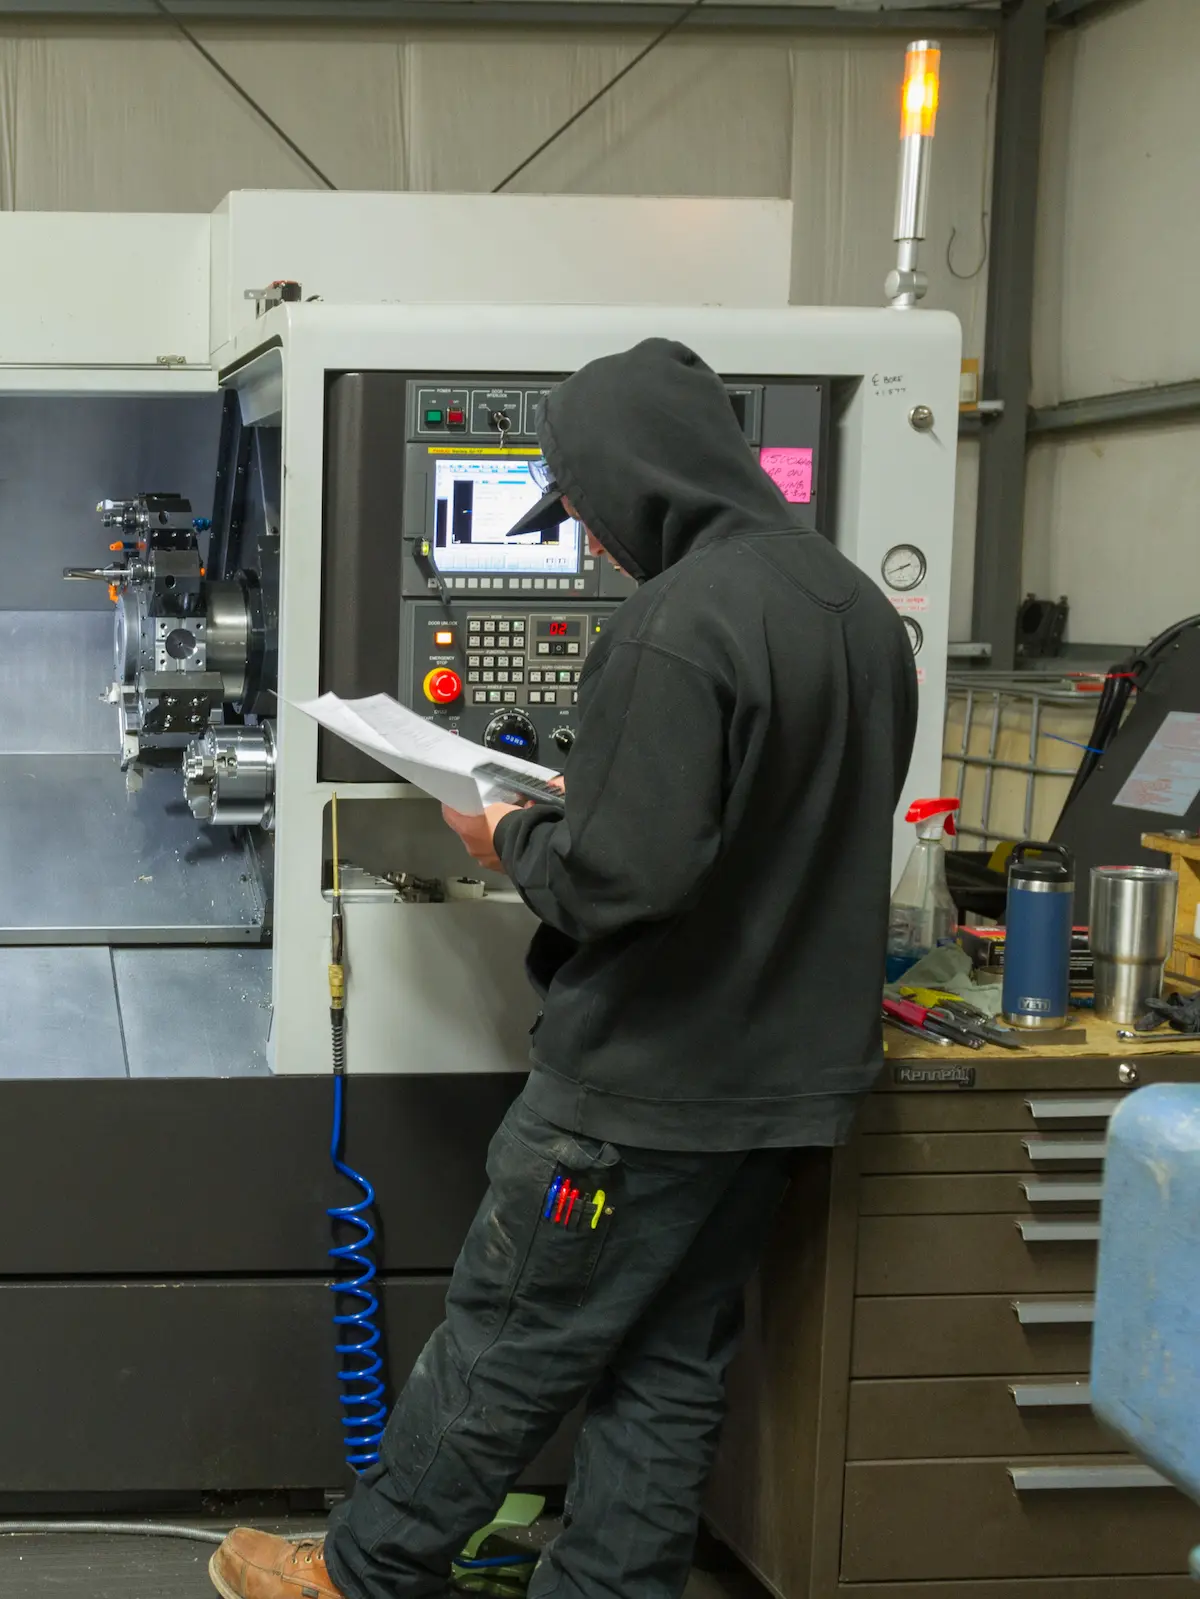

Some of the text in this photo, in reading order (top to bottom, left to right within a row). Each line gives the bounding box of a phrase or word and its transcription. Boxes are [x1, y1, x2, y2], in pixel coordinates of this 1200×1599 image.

[549, 622, 567, 636] 02
[1024, 1000, 1047, 1009] YETI
[900, 1064, 970, 1084] Kennedy
